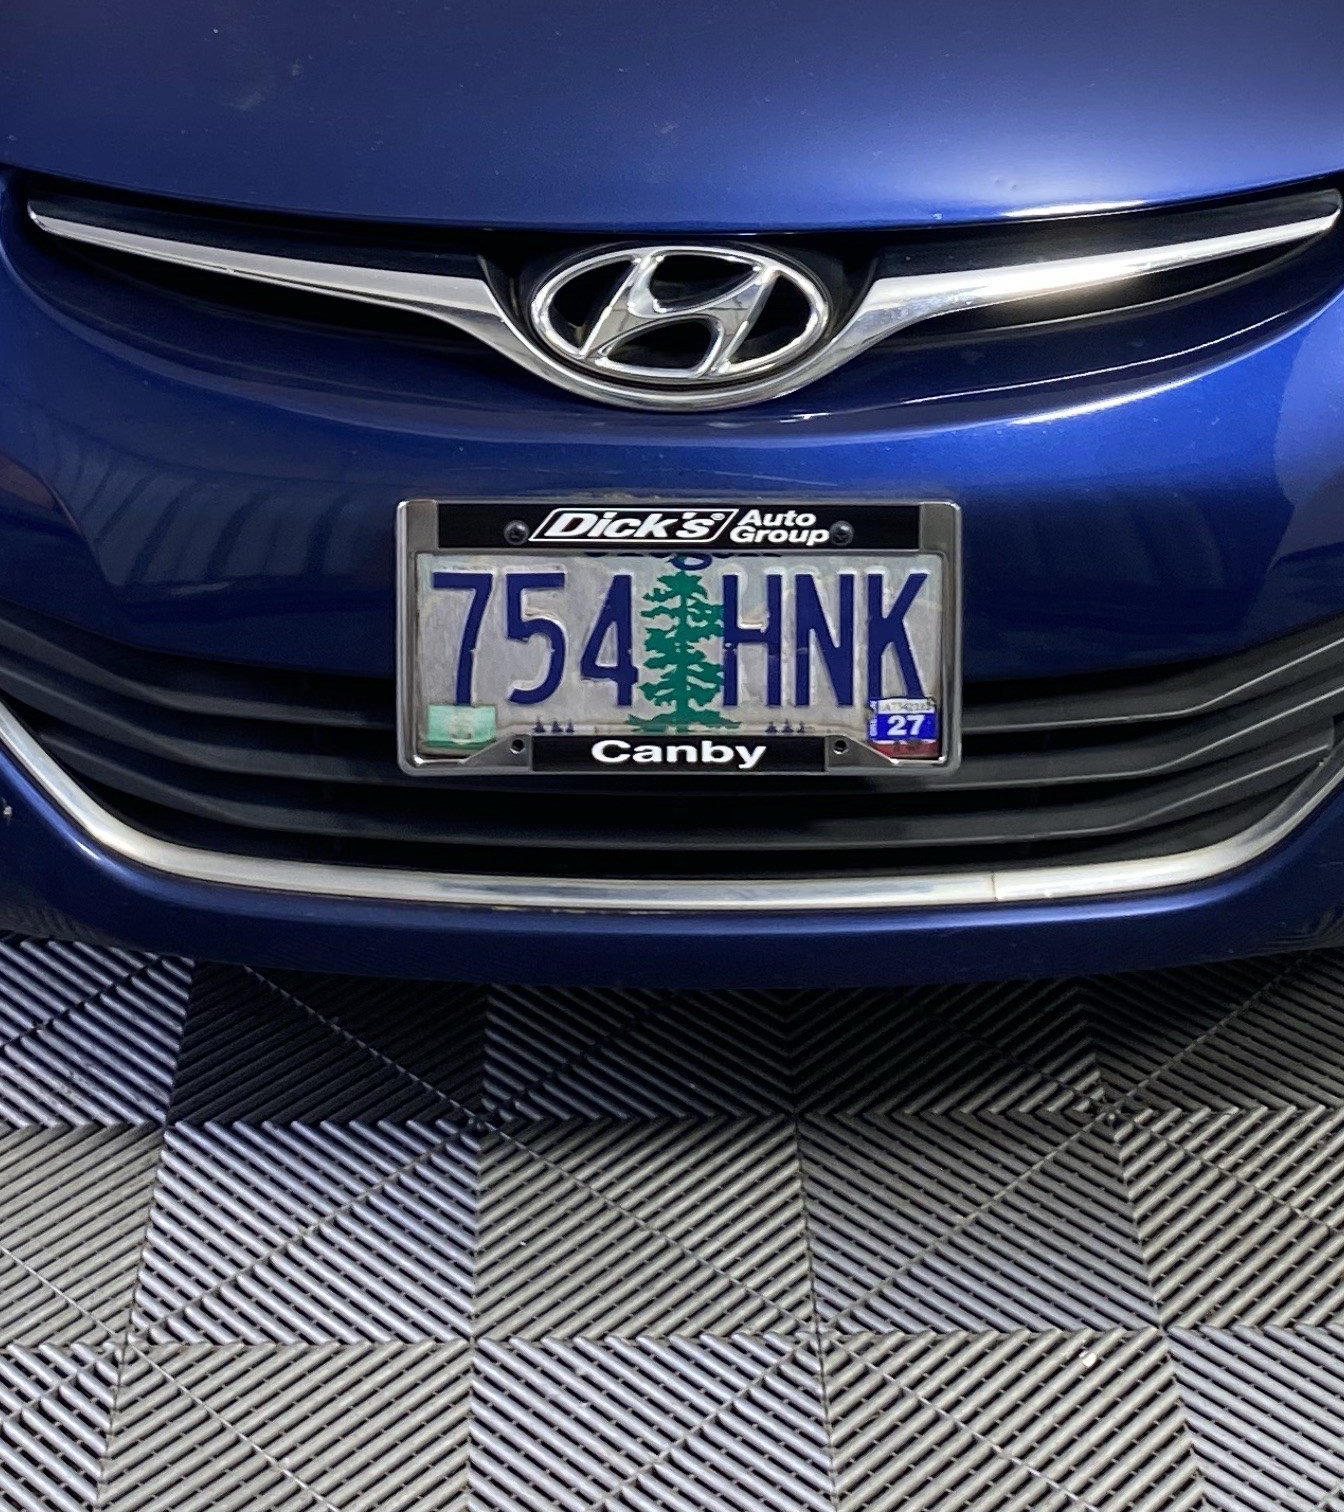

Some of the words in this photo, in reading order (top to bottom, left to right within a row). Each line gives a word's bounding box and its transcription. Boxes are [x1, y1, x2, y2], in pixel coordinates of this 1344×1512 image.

[545, 512, 714, 539] Dick's
[737, 509, 816, 527] Auto
[730, 525, 830, 546] Group
[431, 571, 638, 707] 754
[722, 572, 931, 707] HNK
[887, 714, 926, 736] 27
[591, 739, 767, 769] Canby
